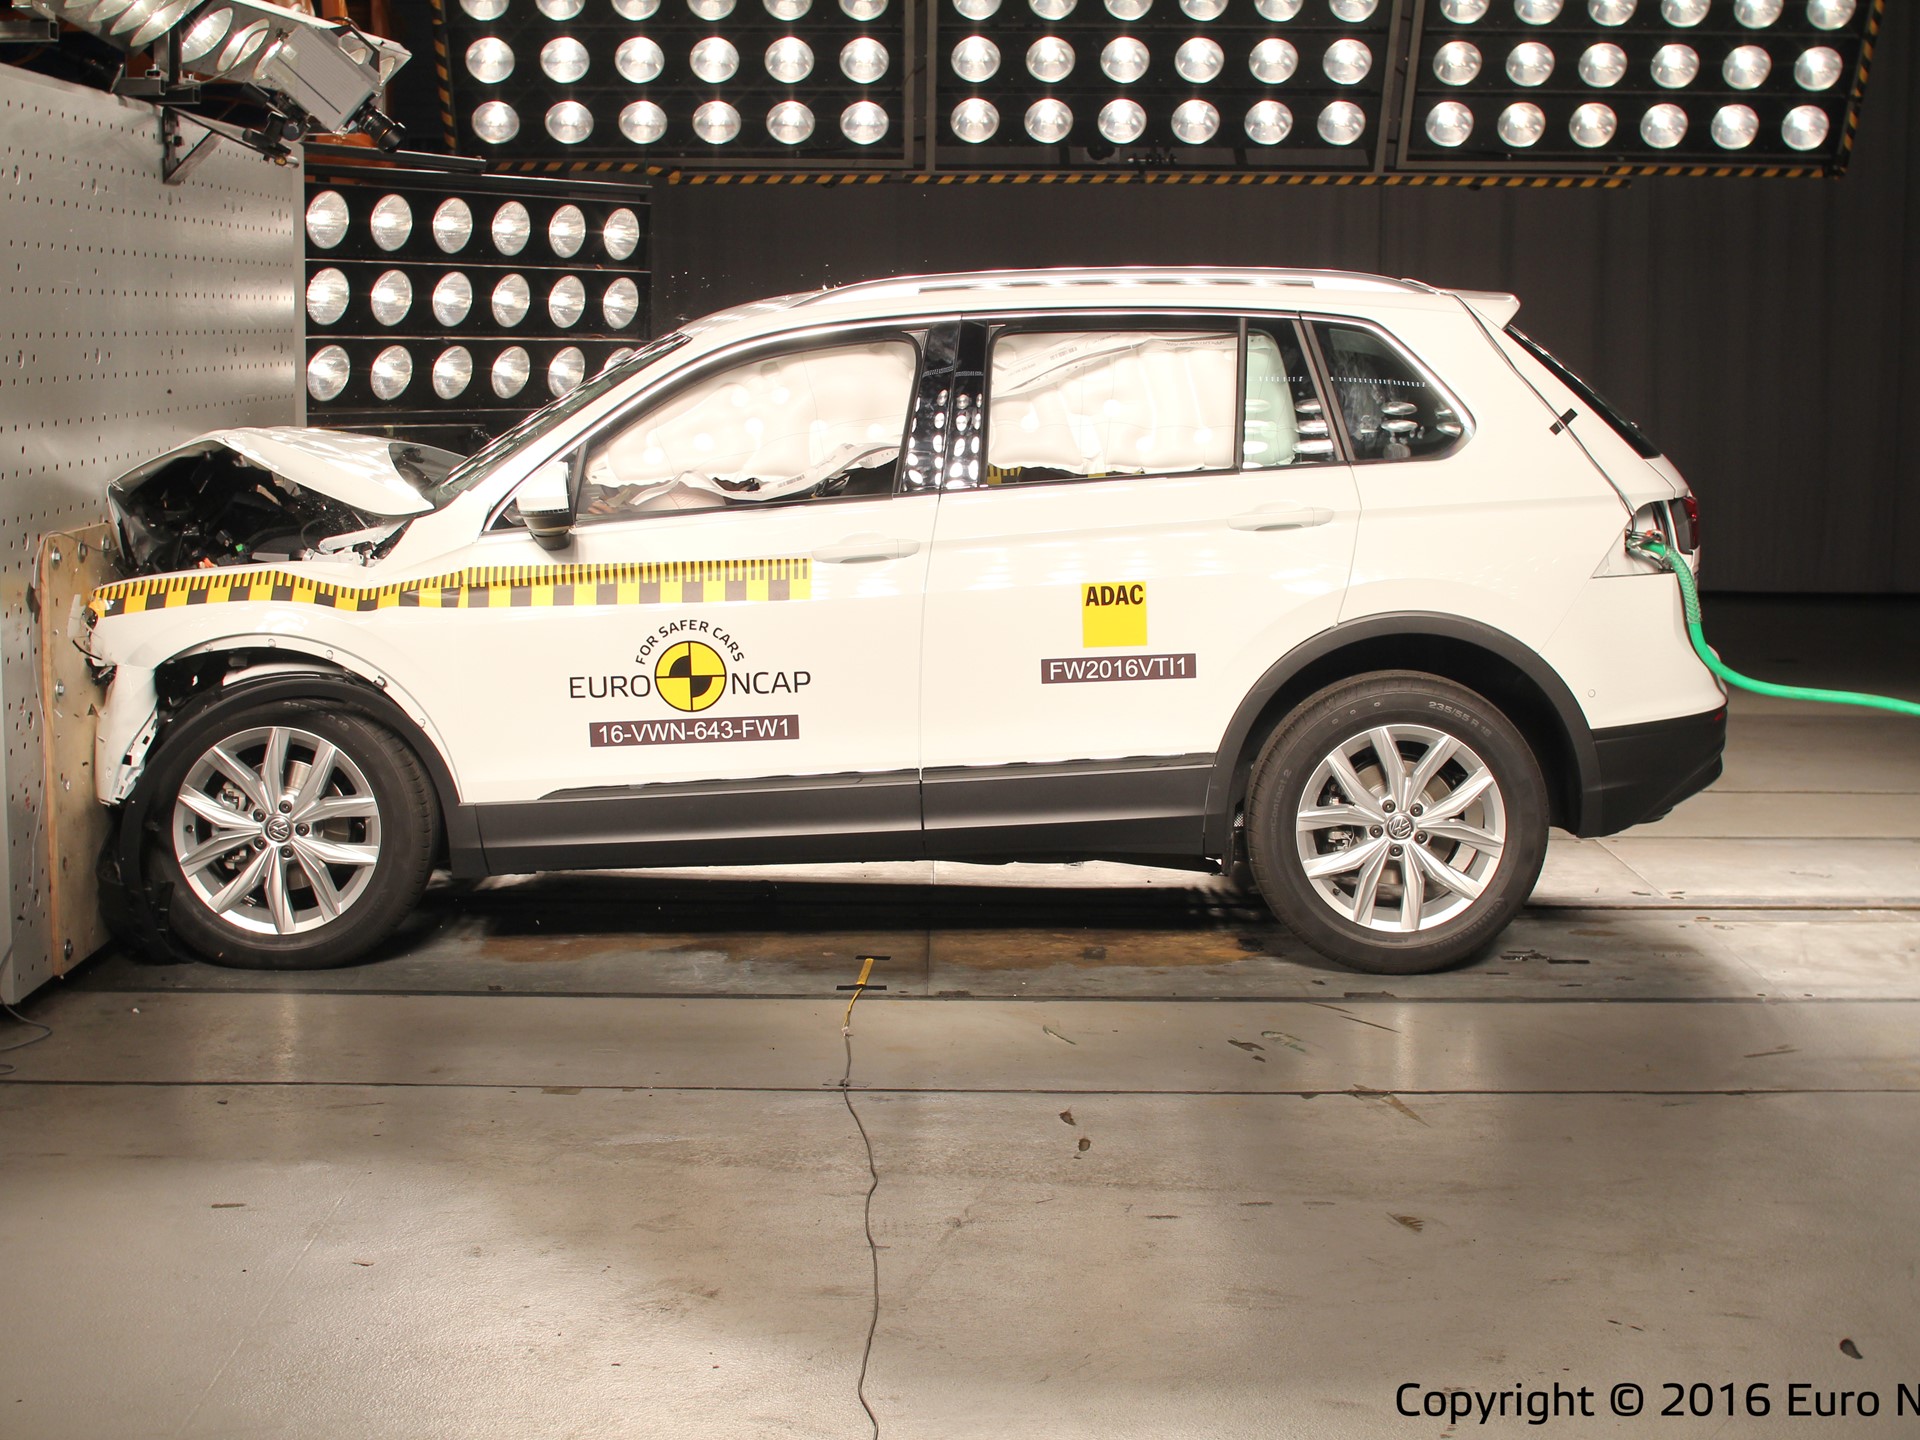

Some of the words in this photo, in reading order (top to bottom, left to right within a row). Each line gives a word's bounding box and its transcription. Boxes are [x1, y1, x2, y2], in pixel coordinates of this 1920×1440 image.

[1085, 584, 1144, 607] ADAC
[635, 635, 659, 665] FOR
[658, 619, 709, 638] SAFER
[712, 627, 745, 662] CARS
[1049, 656, 1186, 681] FW2016VTI1
[569, 674, 651, 699] EURO
[731, 671, 811, 695] NCAP
[1428, 701, 1471, 722] 235/55
[598, 717, 790, 744] 16-VWN-643-FW1
